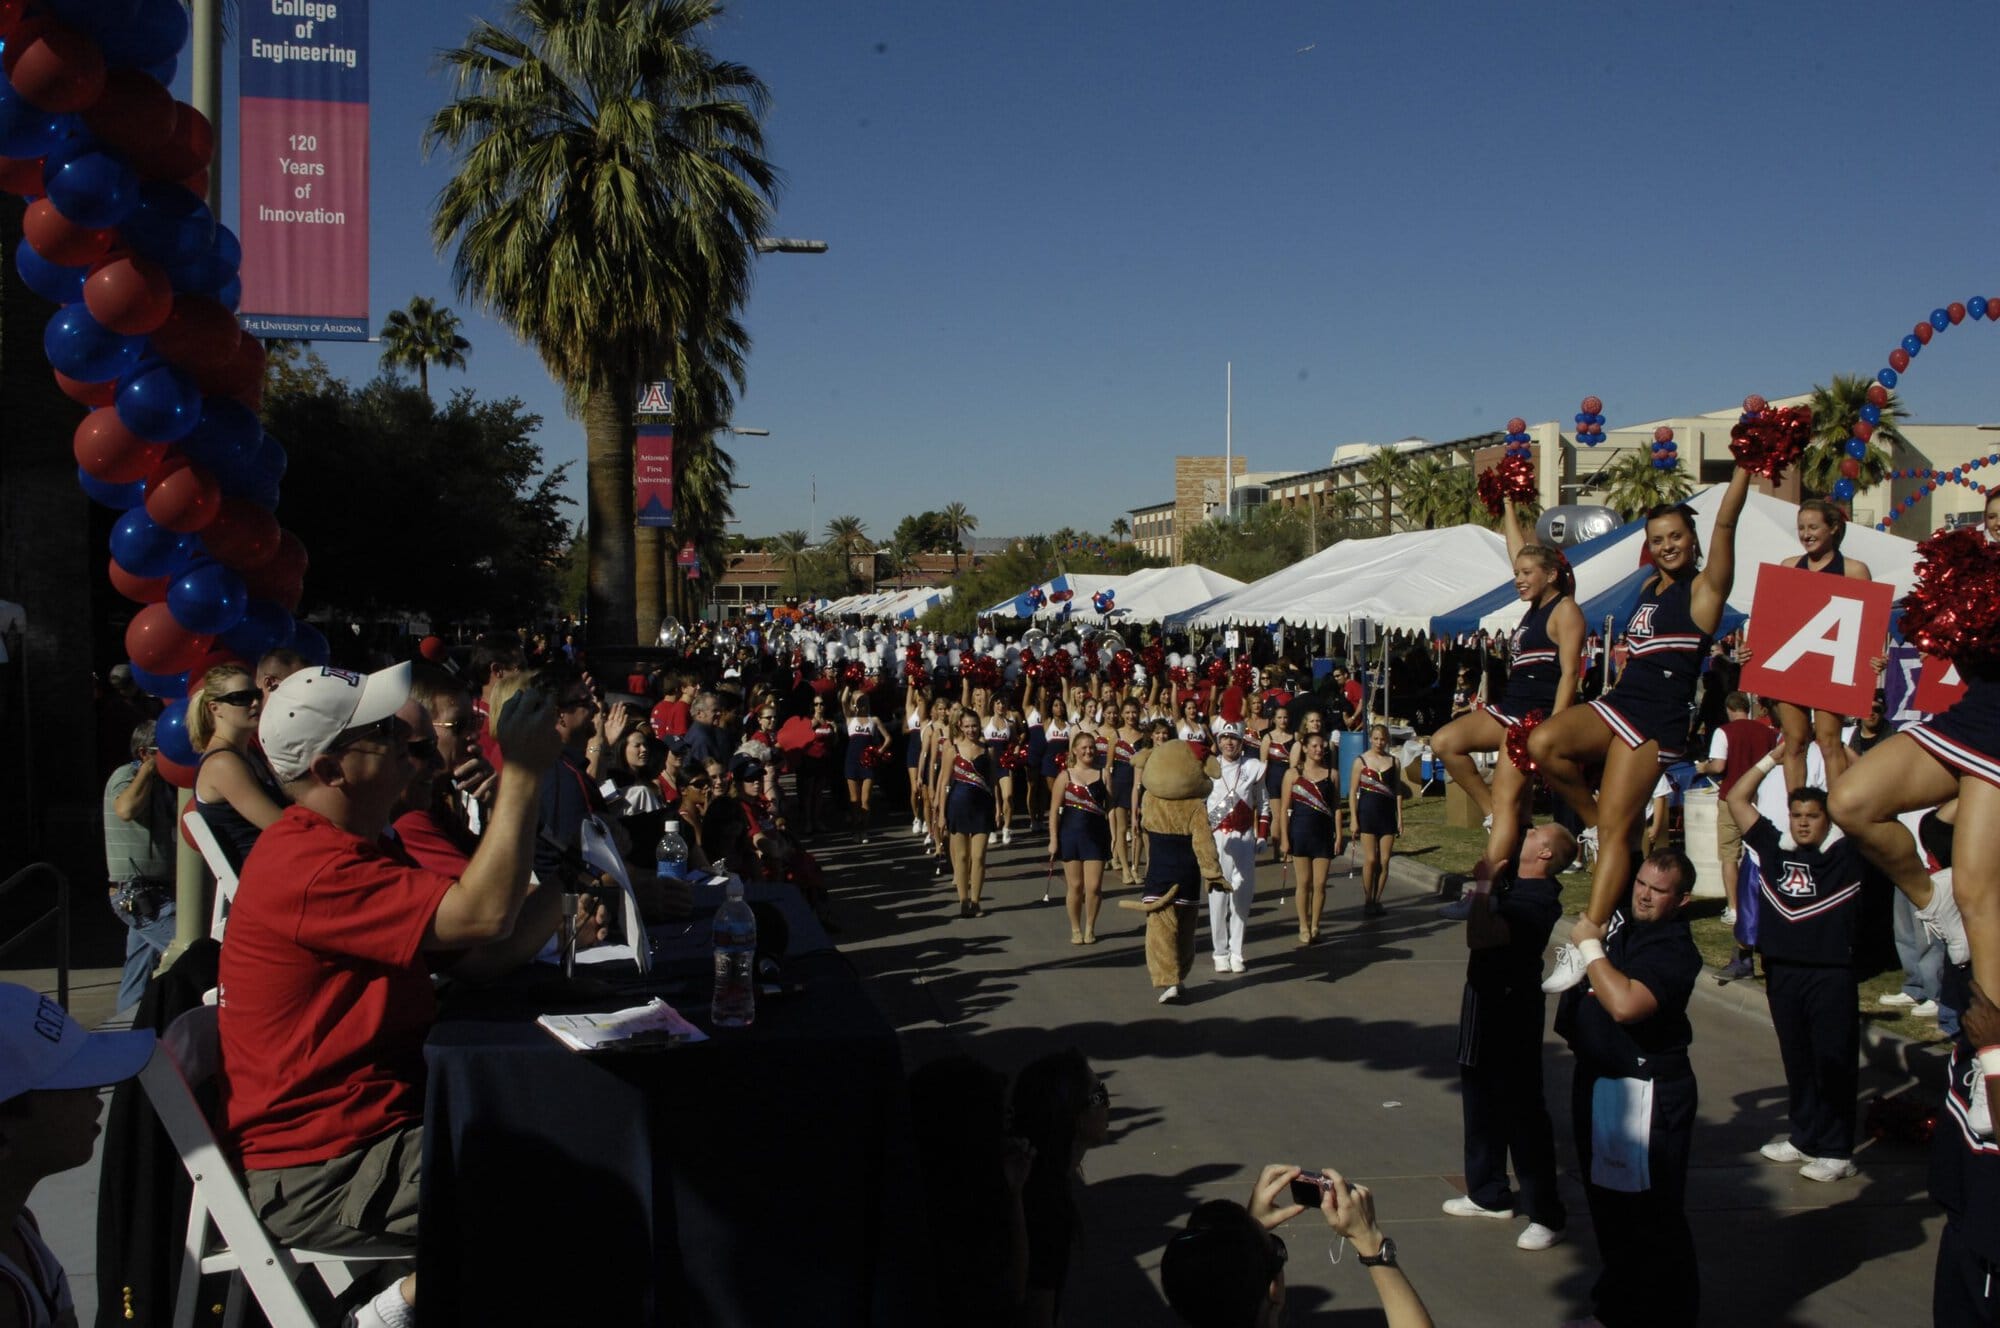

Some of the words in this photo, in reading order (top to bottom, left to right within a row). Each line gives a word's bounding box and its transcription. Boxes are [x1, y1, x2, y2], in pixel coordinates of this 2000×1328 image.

[271, 0, 337, 22] College
[295, 20, 314, 39] of
[251, 38, 357, 68] Engineering
[288, 134, 317, 152] 120
[279, 157, 325, 176] Years
[294, 183, 312, 200] of
[259, 204, 345, 225] Innovation
[638, 381, 672, 414] A
[646, 465, 663, 473] First
[1626, 603, 1660, 639] A
[1761, 595, 1865, 687] A
[1776, 861, 1817, 898] A
